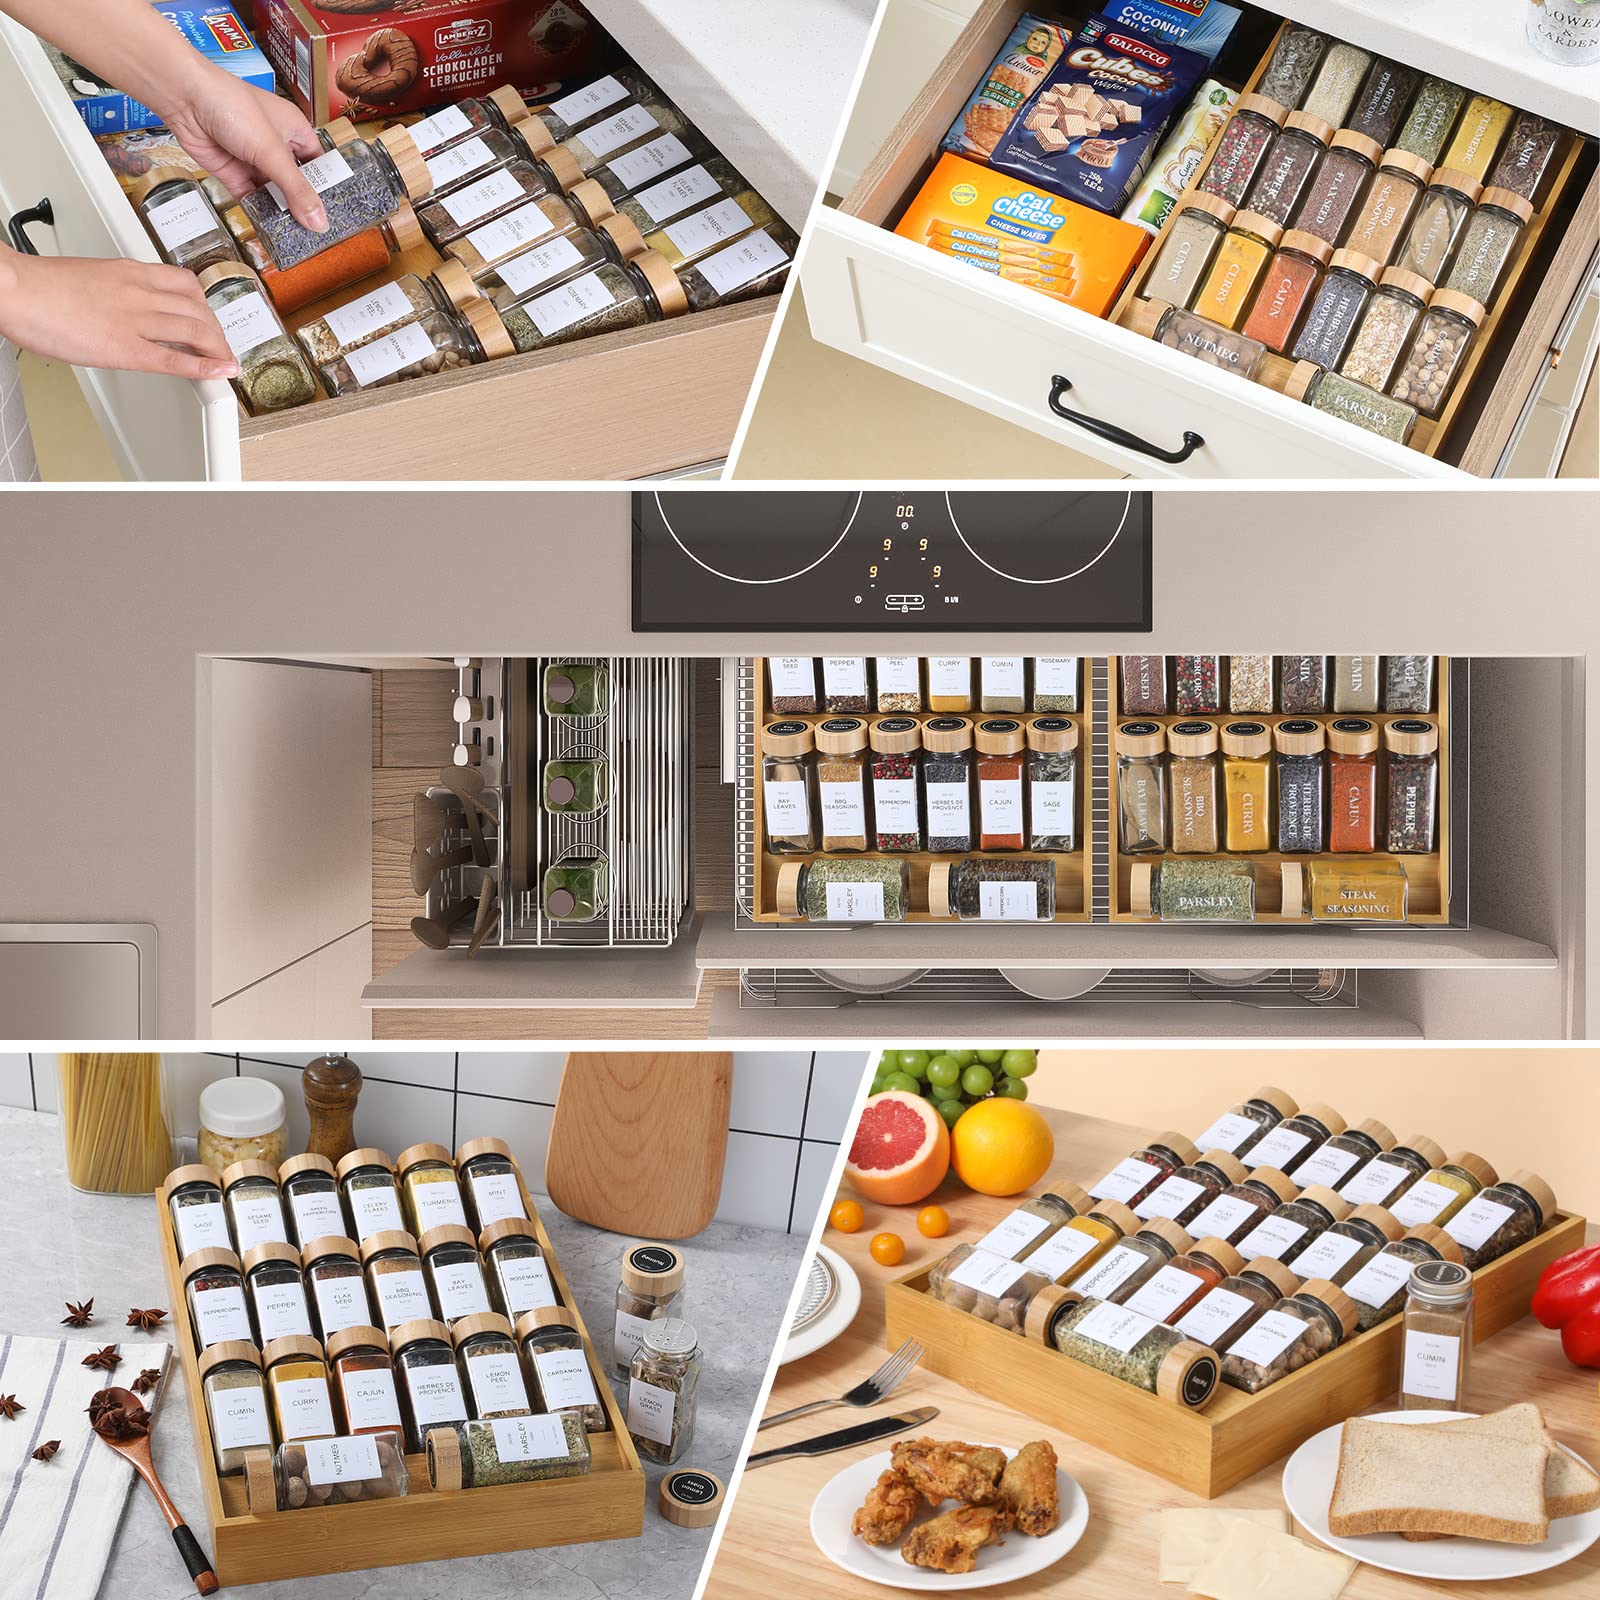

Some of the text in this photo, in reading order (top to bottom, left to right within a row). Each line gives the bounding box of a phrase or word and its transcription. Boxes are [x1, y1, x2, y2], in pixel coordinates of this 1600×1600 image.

[204, 15, 242, 41] AYAM
[1121, 6, 1189, 38] COCONUT
[438, 25, 487, 45] LAMBERTZ
[435, 44, 492, 62] Vollmilch
[1108, 36, 1169, 65] BALOCCO
[423, 52, 503, 78] SCHOKOLADEN
[1068, 48, 1165, 85] Cubes
[1281, 46, 1299, 81] SAGE
[430, 66, 496, 88] LEBKUCHEN
[1088, 70, 1139, 86] Cocoa
[1093, 79, 1129, 93] Wafers
[1363, 72, 1391, 125] PEPPERCORN
[1378, 88, 1395, 117] GREEN
[1410, 97, 1434, 138] FLAKES
[1424, 101, 1447, 142] CELERY
[1465, 112, 1491, 166] TURMERIC
[1222, 131, 1250, 186] PEPPERCORN
[1516, 140, 1538, 169] MINT
[678, 178, 695, 196] CELERY
[1268, 155, 1294, 199] PEPPER
[671, 181, 689, 199] FLAKES
[1316, 171, 1345, 225] FLAX SEED
[1018, 192, 1054, 212] Cal
[1362, 183, 1391, 241] SEASONING
[160, 206, 199, 228] NUTMEG
[993, 197, 1064, 229] Cheese
[1380, 205, 1397, 228] BBQ
[702, 210, 727, 237] TURMERIC
[990, 219, 1047, 241] CHEESE WAFER
[951, 229, 999, 245] Cal Cheese
[1416, 227, 1437, 266] LEAVES
[741, 247, 758, 263] MINT
[951, 242, 1000, 258] Cal Cheese
[1466, 227, 1496, 285] ROSEMARY
[967, 257, 1001, 271] Cheese
[1168, 241, 1192, 284] CUMIN
[1215, 263, 1241, 307] CURRY
[1268, 277, 1292, 320] CAJUN
[1306, 292, 1337, 347] PROVENCE
[1319, 297, 1350, 353] HERBES DE
[1186, 332, 1241, 364] NUTMEG
[1334, 395, 1391, 427] PARSLEY
[883, 538, 892, 550] 9
[919, 538, 928, 550] 9
[869, 565, 878, 578] 9
[932, 565, 942, 578] 9
[1141, 674, 1150, 700] SEED
[1137, 779, 1148, 841] BAY LEAVES
[1183, 777, 1194, 836] SEASONING
[1195, 796, 1204, 817] BBQ
[1242, 793, 1254, 836] CURRY
[1288, 783, 1297, 839] PROVENCE
[1303, 783, 1312, 840] HERBES DE
[1349, 786, 1360, 828] CAJUN
[1405, 786, 1417, 832] PEPPER
[1179, 896, 1236, 907] PARSLEY
[1340, 890, 1377, 900] STEAK
[1327, 904, 1390, 914] SEASONING
[422, 1198, 458, 1207] TURMERIC
[488, 1189, 507, 1197] MINT
[1406, 1194, 1441, 1210] TURMERIC
[193, 1221, 213, 1229] SAGE
[247, 1213, 272, 1221] SESAME
[1470, 1212, 1490, 1222] MINT
[509, 1273, 544, 1282] ROSEMARY
[1082, 1250, 1129, 1293] PEPPERCORN
[385, 1291, 423, 1300] SEASONING
[447, 1284, 473, 1292] LEAVES
[1154, 1282, 1179, 1295] CAJUN
[203, 1307, 241, 1316] PEPPERCORN
[266, 1301, 297, 1310] PEPPER
[620, 1330, 643, 1343] NUTM
[1416, 1352, 1446, 1364] CUMIN
[485, 1370, 511, 1378] LEMON
[546, 1368, 582, 1377] CARDAMOM
[357, 1389, 385, 1397] CAJUN
[417, 1383, 444, 1391] HERBES
[418, 1387, 456, 1396] PROVENCE
[228, 1407, 255, 1417] CUMIN
[292, 1398, 320, 1406] CURRY
[639, 1396, 663, 1408] LEMON
[639, 1402, 661, 1413] GRASS
[517, 1421, 530, 1455] PARSLEY
[331, 1444, 343, 1476] NUTMEG
[681, 1484, 704, 1496] Lemon
[687, 1480, 704, 1489] Grass
